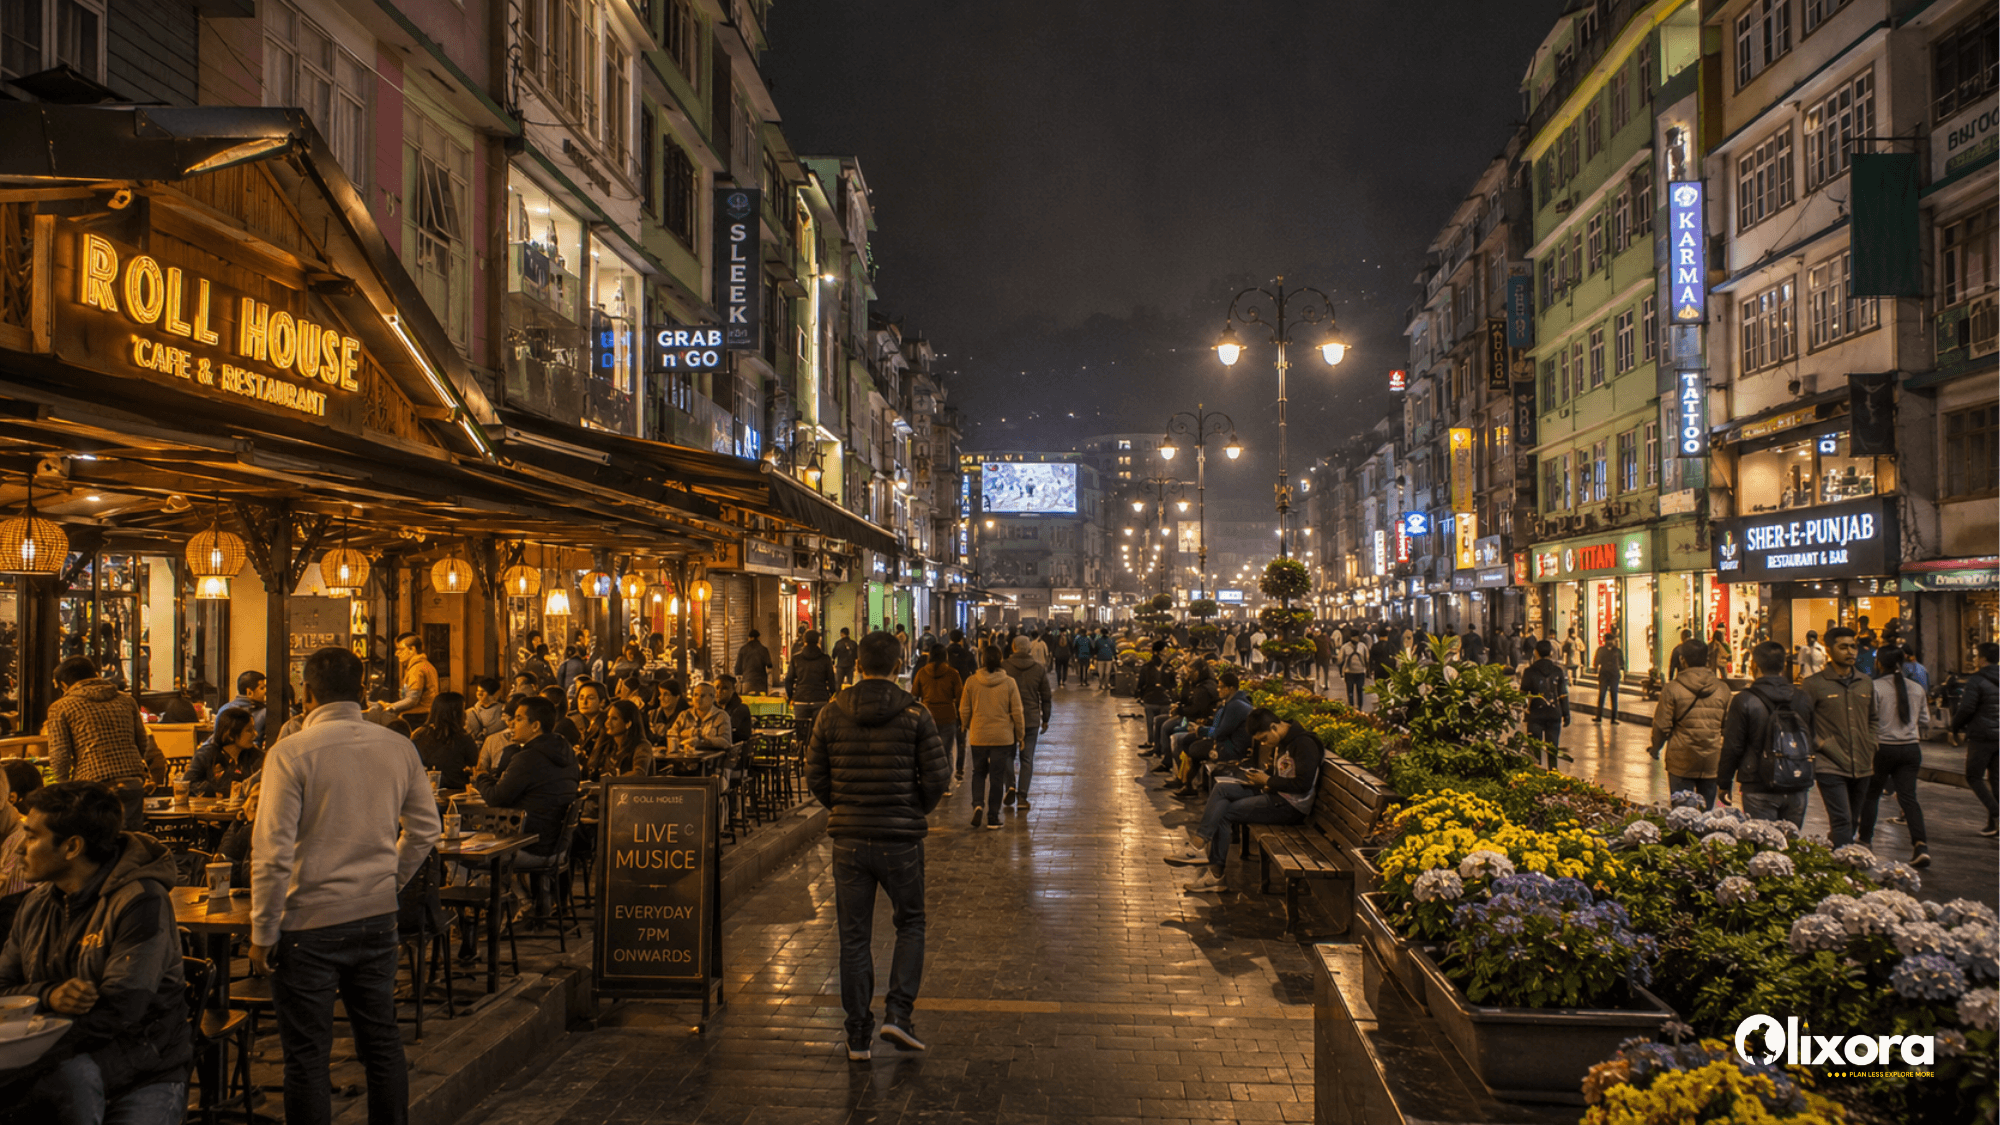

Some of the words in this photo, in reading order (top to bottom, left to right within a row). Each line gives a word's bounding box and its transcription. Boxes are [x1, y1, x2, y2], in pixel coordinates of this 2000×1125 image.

[1677, 211, 1699, 303] KARMA
[729, 223, 749, 324] SLEEK
[81, 233, 219, 346] ROLL
[240, 296, 361, 393] HOUSE
[657, 330, 723, 347] GRAB
[662, 353, 677, 367] n
[685, 350, 719, 367] GO
[131, 335, 192, 379] CAFE
[197, 357, 214, 385] &
[221, 363, 328, 417] RESTAURANT
[1681, 373, 1701, 453] TATTOO
[1746, 513, 1874, 550] SHER-E-PUNJAB
[1766, 552, 1819, 569] RESTAURANT
[1829, 549, 1849, 565] BAR
[633, 823, 679, 843] LIVE
[615, 850, 696, 869] MUSICE
[614, 905, 694, 919] EVERYDAY
[637, 928, 670, 941] 7PM
[613, 949, 692, 963] ONWARDS
